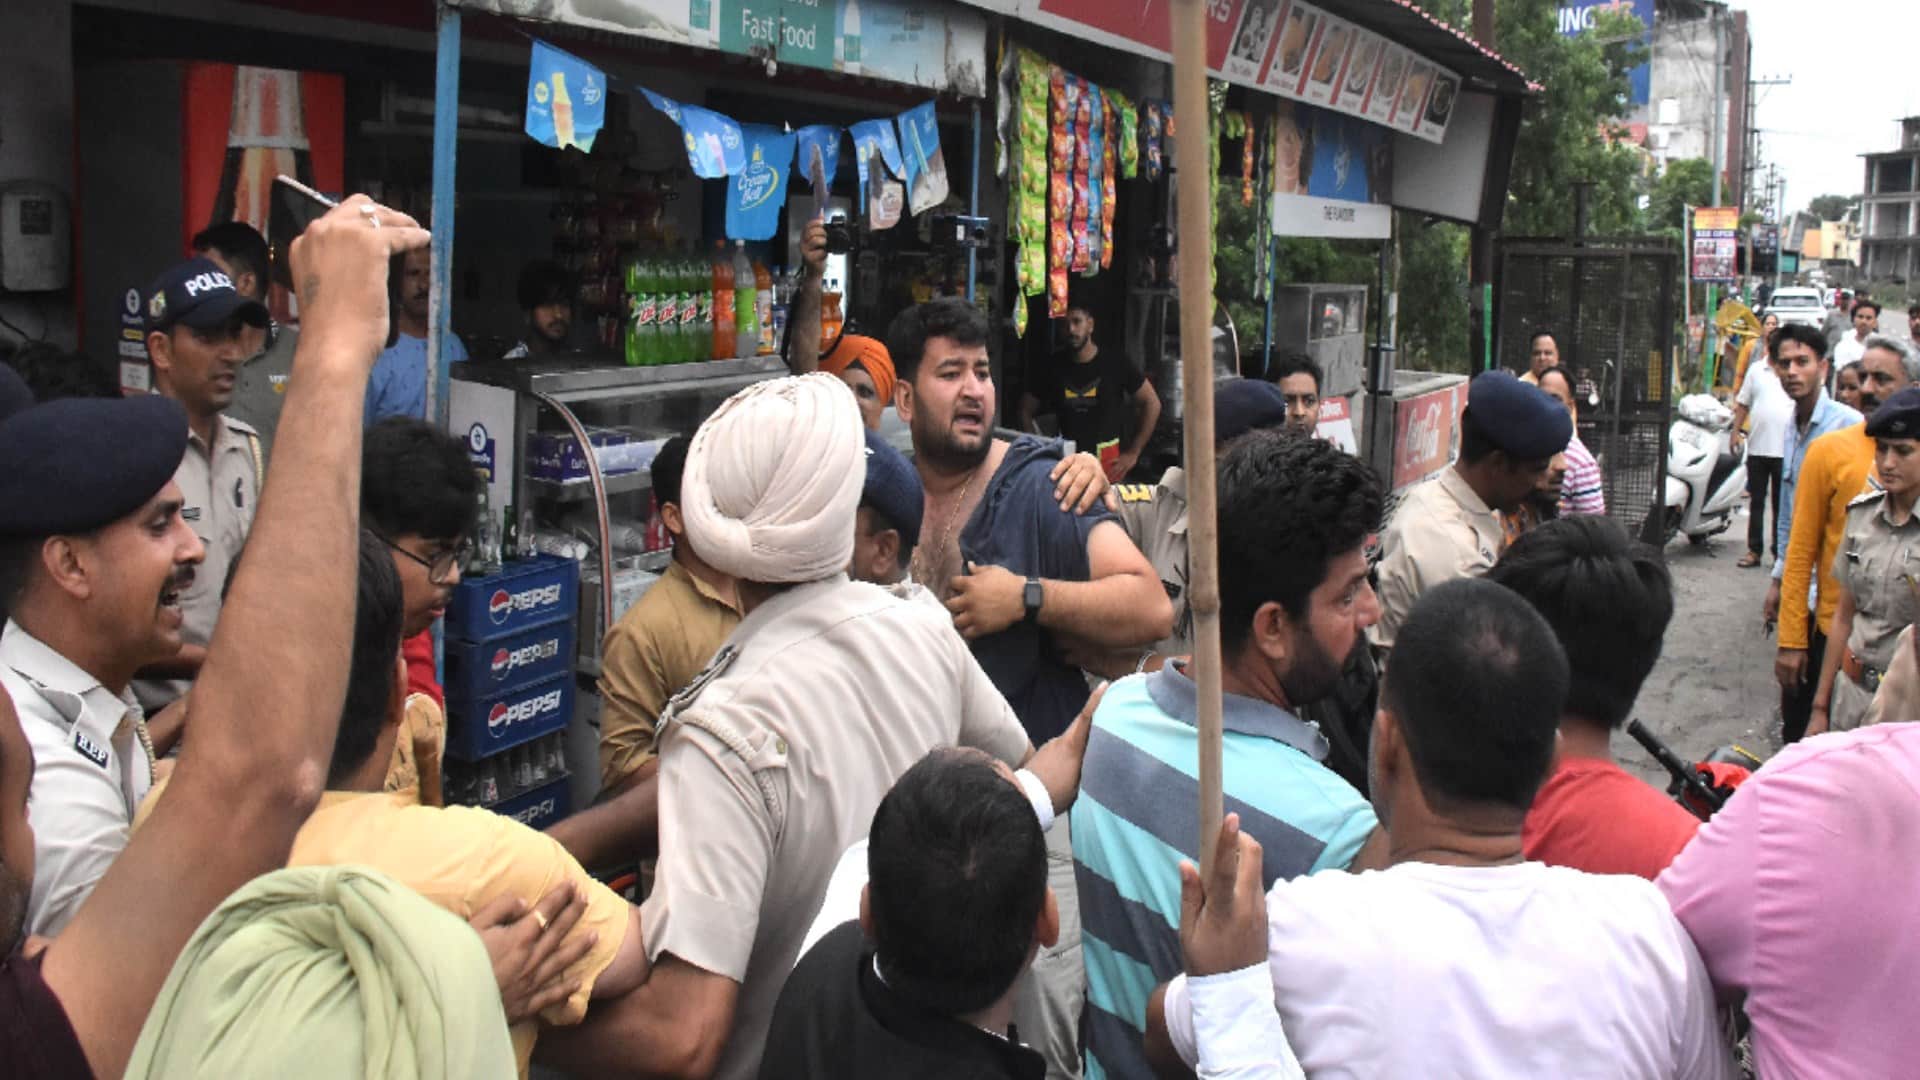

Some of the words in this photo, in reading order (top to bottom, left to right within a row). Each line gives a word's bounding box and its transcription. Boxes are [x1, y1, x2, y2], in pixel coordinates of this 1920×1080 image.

[741, 8, 775, 42] Fast
[779, 17, 816, 50] Food
[738, 172, 770, 191] Cream
[741, 186, 763, 206] Bell
[506, 583, 561, 613] PEPSI
[507, 638, 558, 668] PEPSI
[505, 689, 562, 725] PEPSI
[511, 797, 555, 823] EPSI
